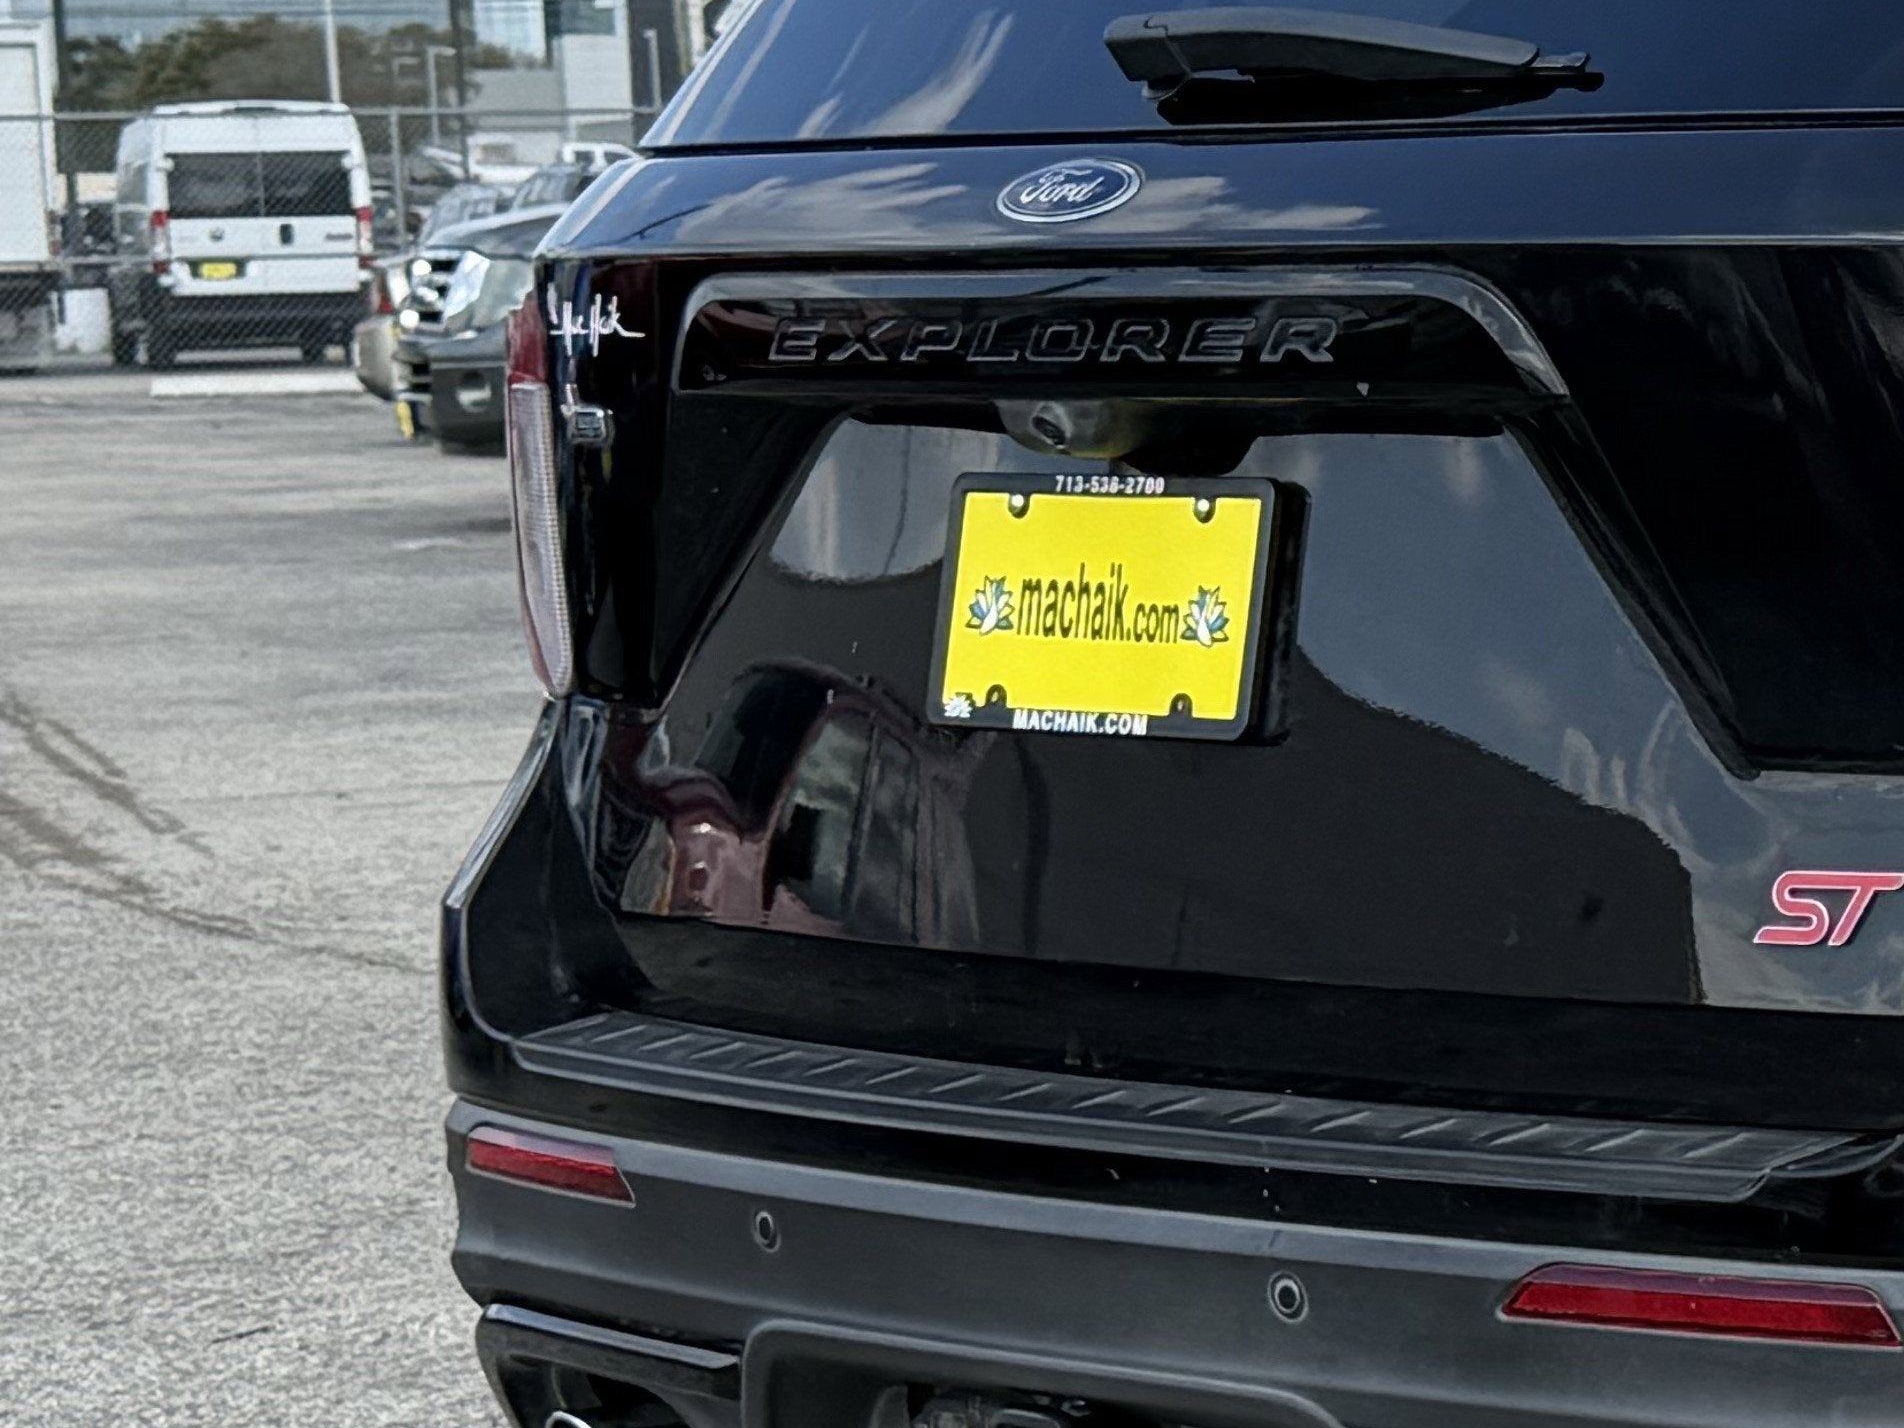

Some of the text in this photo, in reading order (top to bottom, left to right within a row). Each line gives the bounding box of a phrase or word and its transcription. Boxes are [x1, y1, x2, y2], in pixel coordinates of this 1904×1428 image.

[1019, 168, 1105, 204] Ford
[768, 316, 1340, 363] EXPLORER
[1016, 562, 1180, 644] machaik.com
[1012, 708, 1148, 736] MACHAIK.COM
